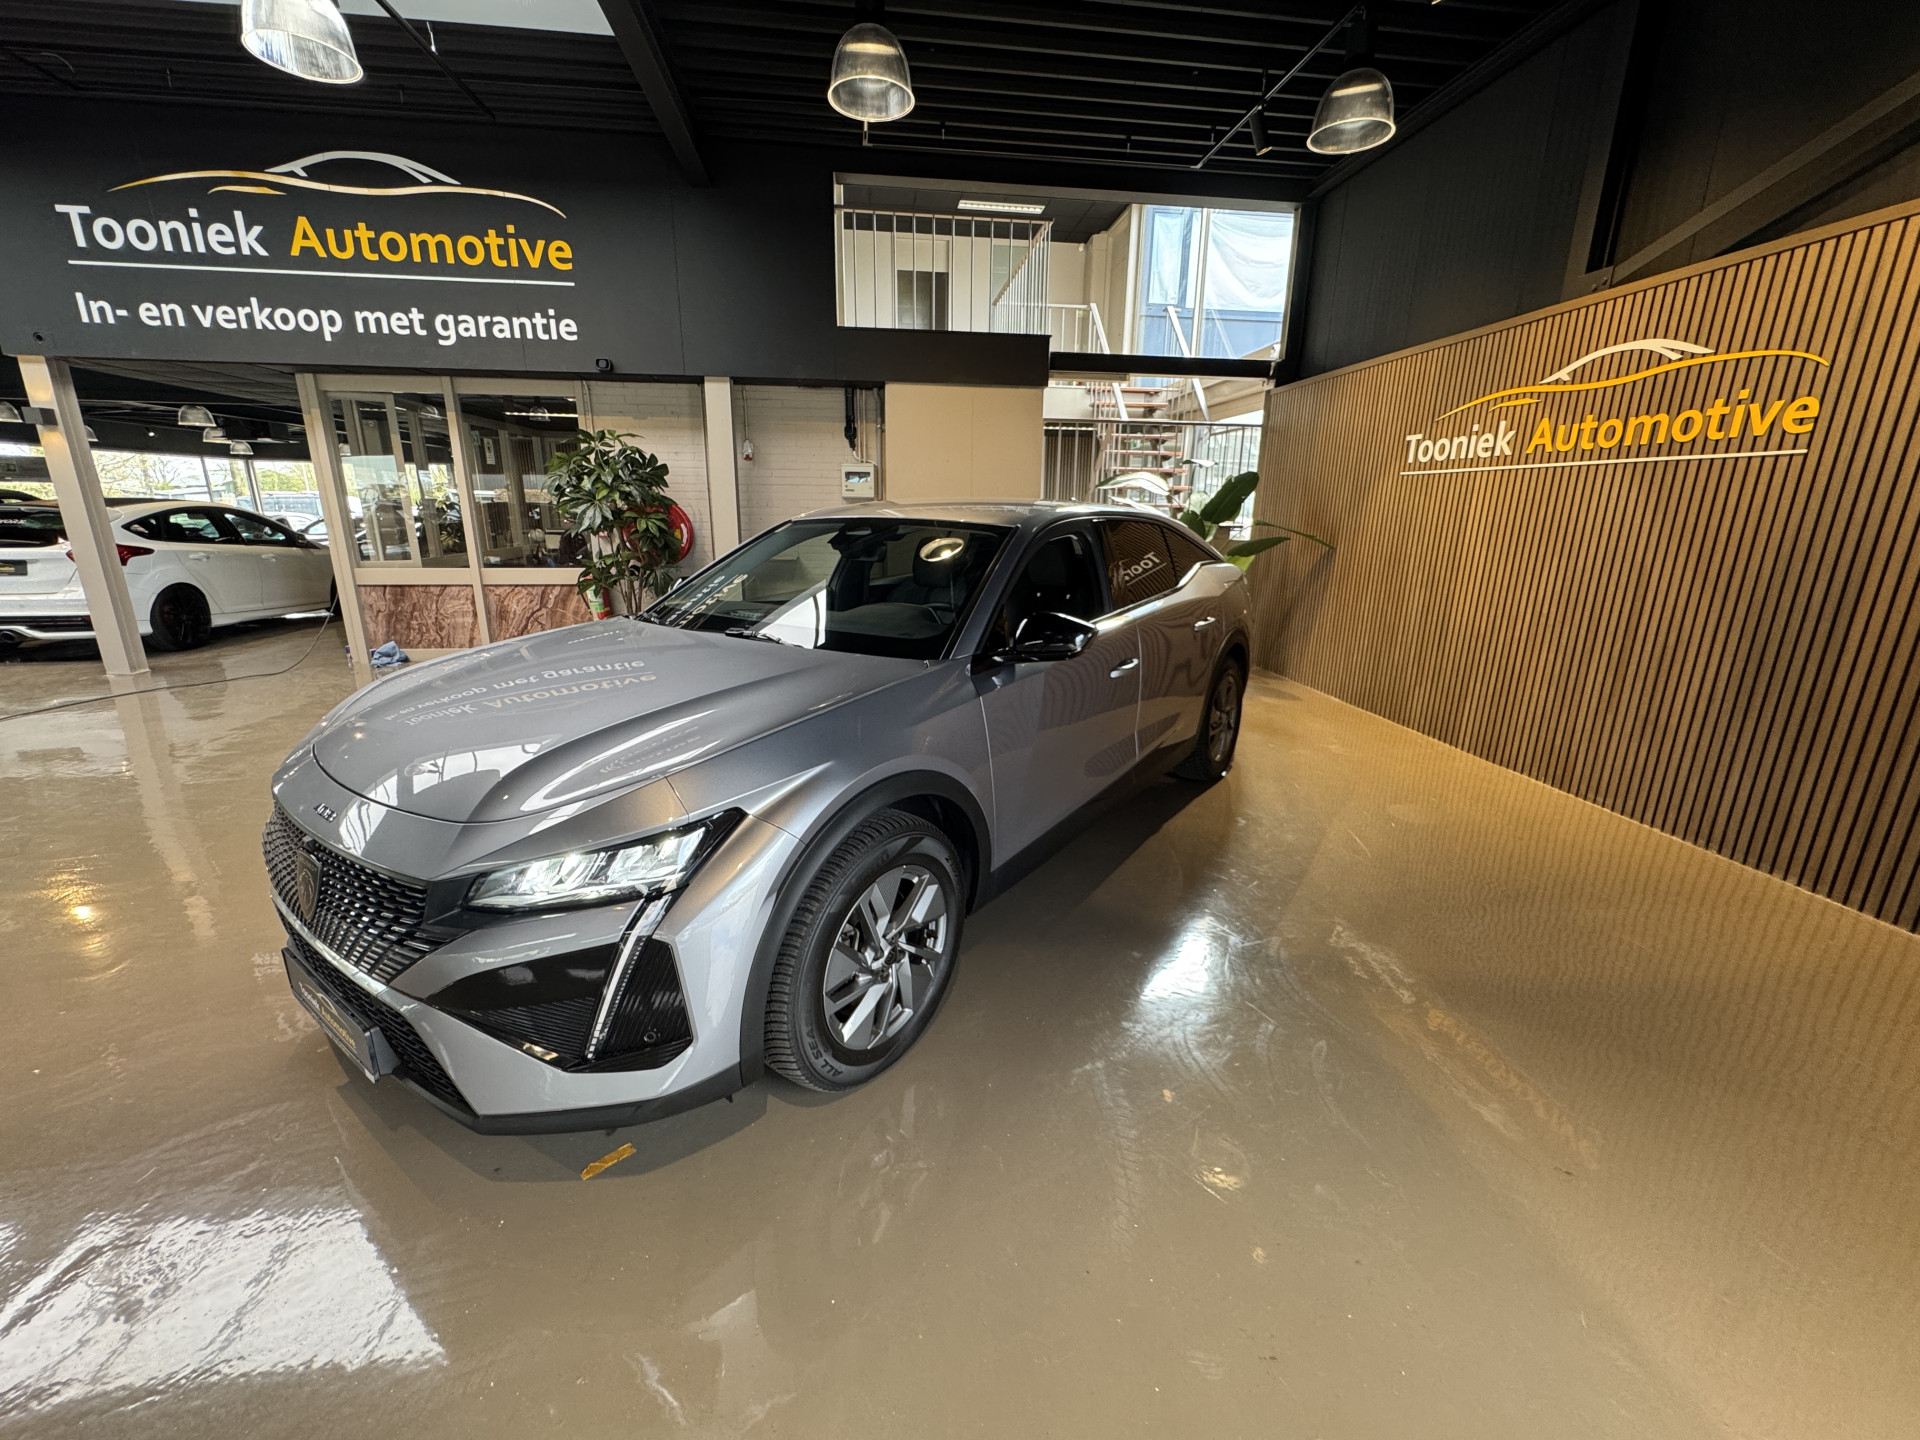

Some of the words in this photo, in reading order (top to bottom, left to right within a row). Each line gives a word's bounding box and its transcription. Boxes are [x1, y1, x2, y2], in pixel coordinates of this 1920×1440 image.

[54, 203, 269, 257] Tooniek
[290, 215, 573, 271] Automotive
[74, 291, 129, 325] In-
[138, 301, 187, 328] en
[190, 297, 343, 342] verkoop
[353, 309, 428, 337] met
[434, 308, 579, 347] garantie
[1405, 420, 1516, 464] Tooniek
[1525, 388, 1820, 454] Automotive
[820, 1059, 844, 1078] ALL
